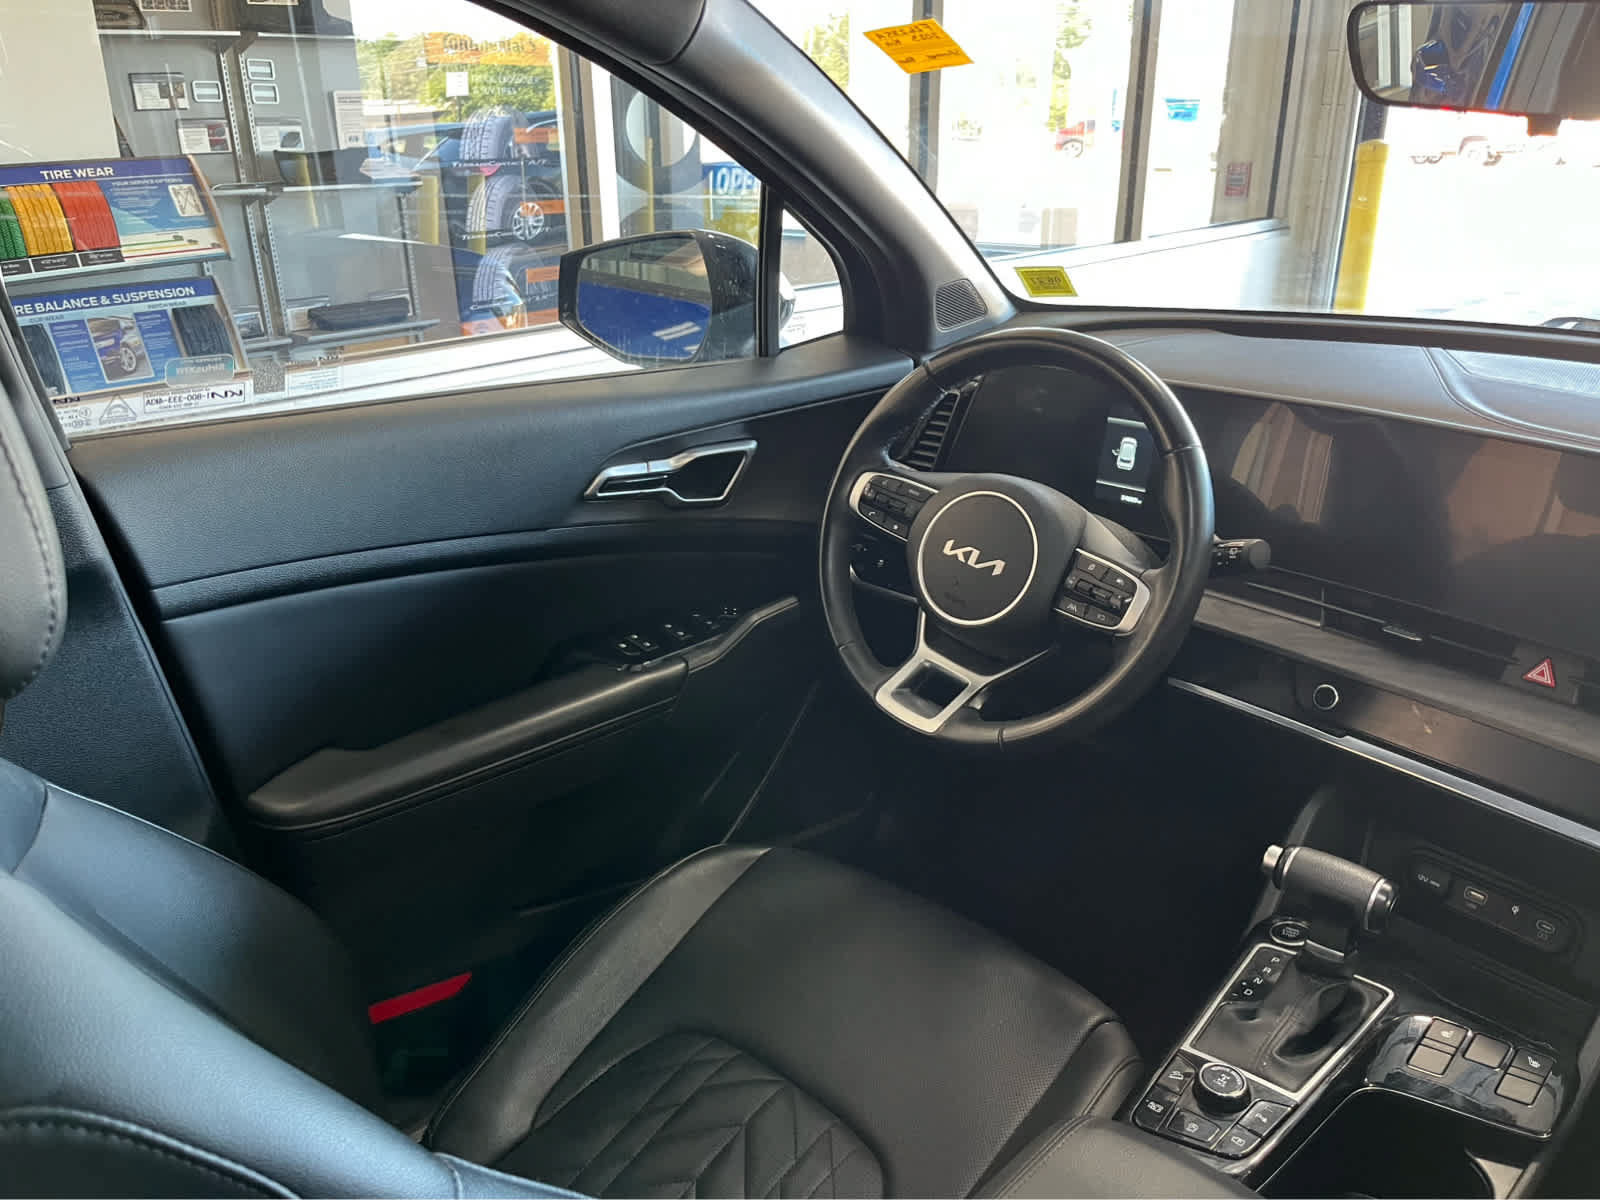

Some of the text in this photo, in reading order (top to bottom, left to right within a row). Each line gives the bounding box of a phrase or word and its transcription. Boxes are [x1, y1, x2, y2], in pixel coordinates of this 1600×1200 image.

[39, 166, 115, 180] TIRE WEAR
[13, 286, 196, 315] RE BALANCE & SUSPENSION
